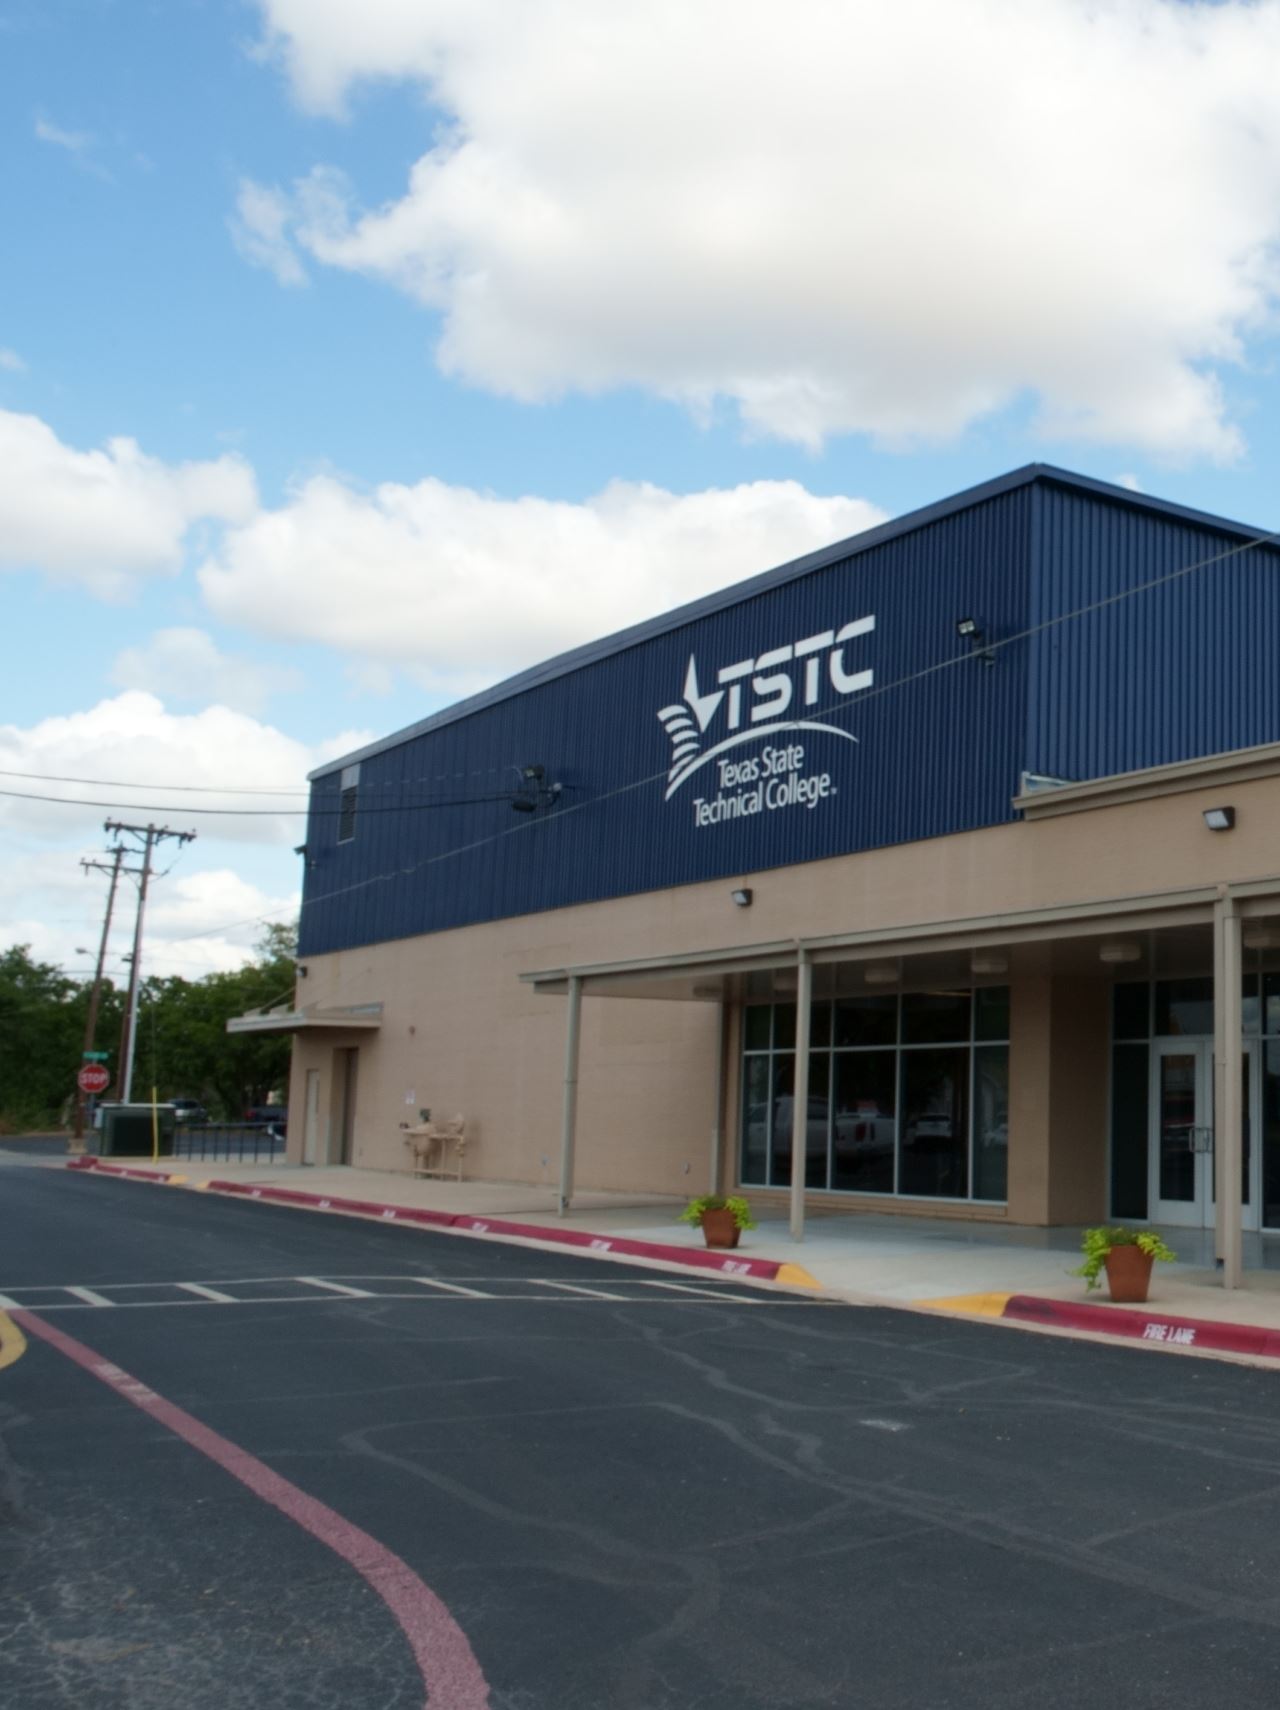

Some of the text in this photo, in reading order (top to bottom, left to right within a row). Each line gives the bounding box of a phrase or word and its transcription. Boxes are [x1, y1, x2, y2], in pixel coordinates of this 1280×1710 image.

[718, 614, 876, 730] TSTC
[717, 744, 805, 789] Texas State
[693, 780, 763, 828] Technical
[80, 1073, 107, 1084] STOP
[1142, 1322, 1168, 1341] FIRE
